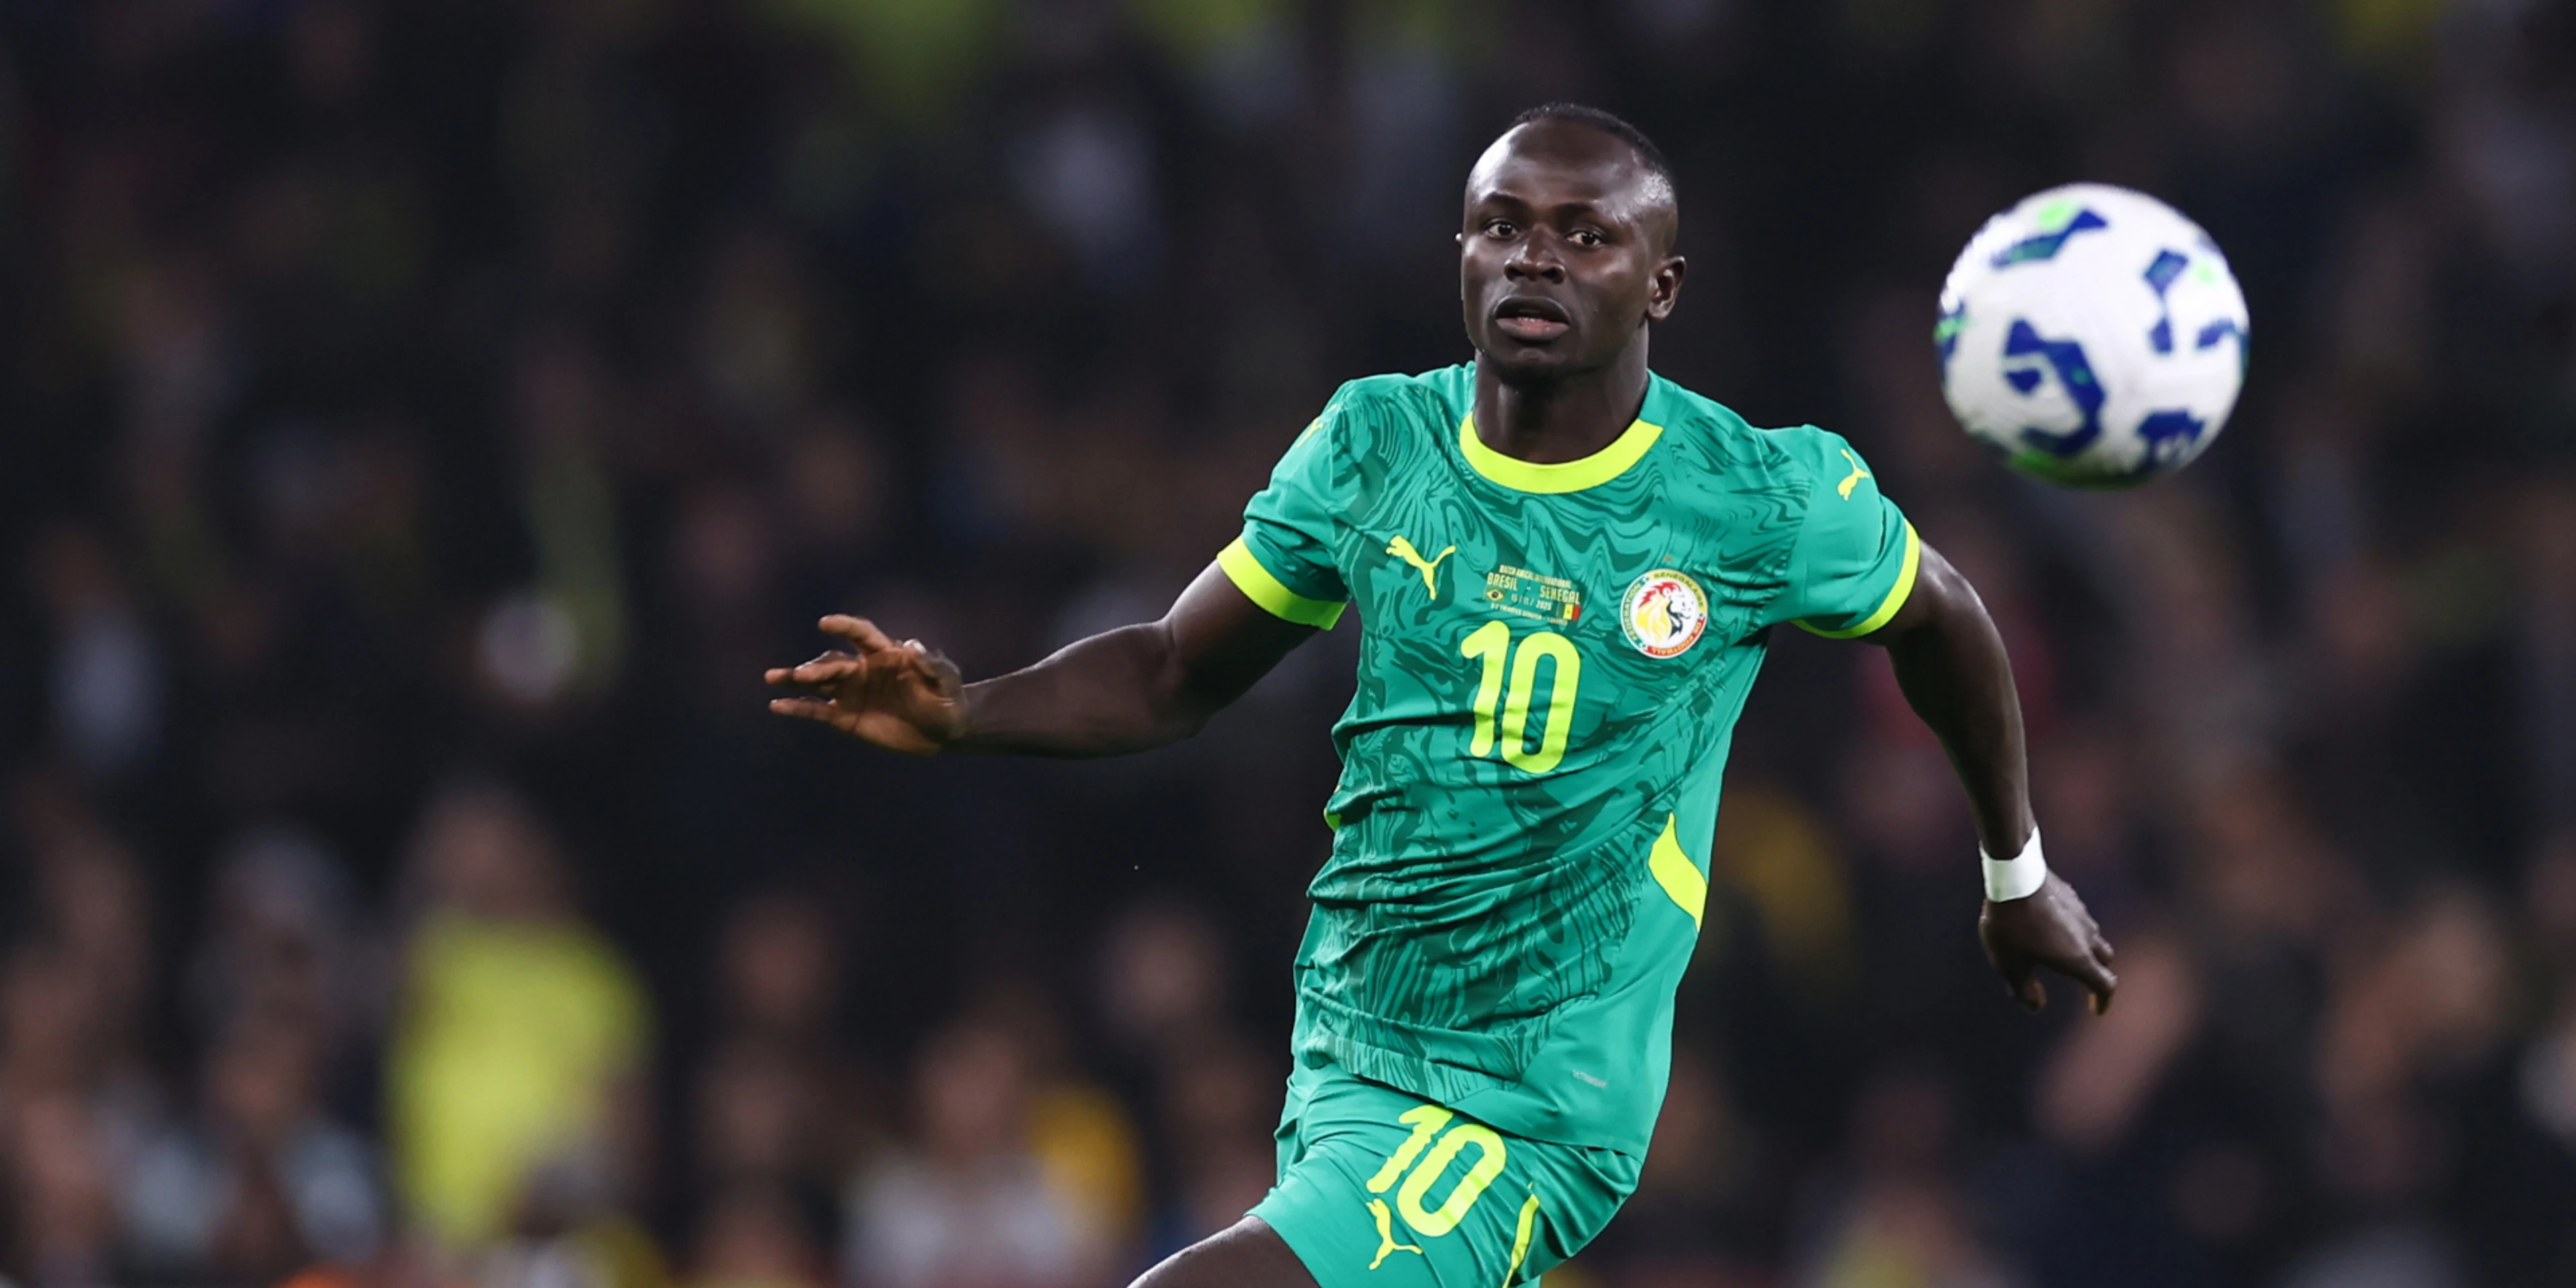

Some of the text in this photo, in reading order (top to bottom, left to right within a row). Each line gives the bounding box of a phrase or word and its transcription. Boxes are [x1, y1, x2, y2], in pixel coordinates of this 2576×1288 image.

[1487, 572, 1518, 591] BRESIL
[1540, 584, 1580, 604] SENEGAL
[1461, 620, 1580, 773] 10
[1366, 1104, 1506, 1237] 10
